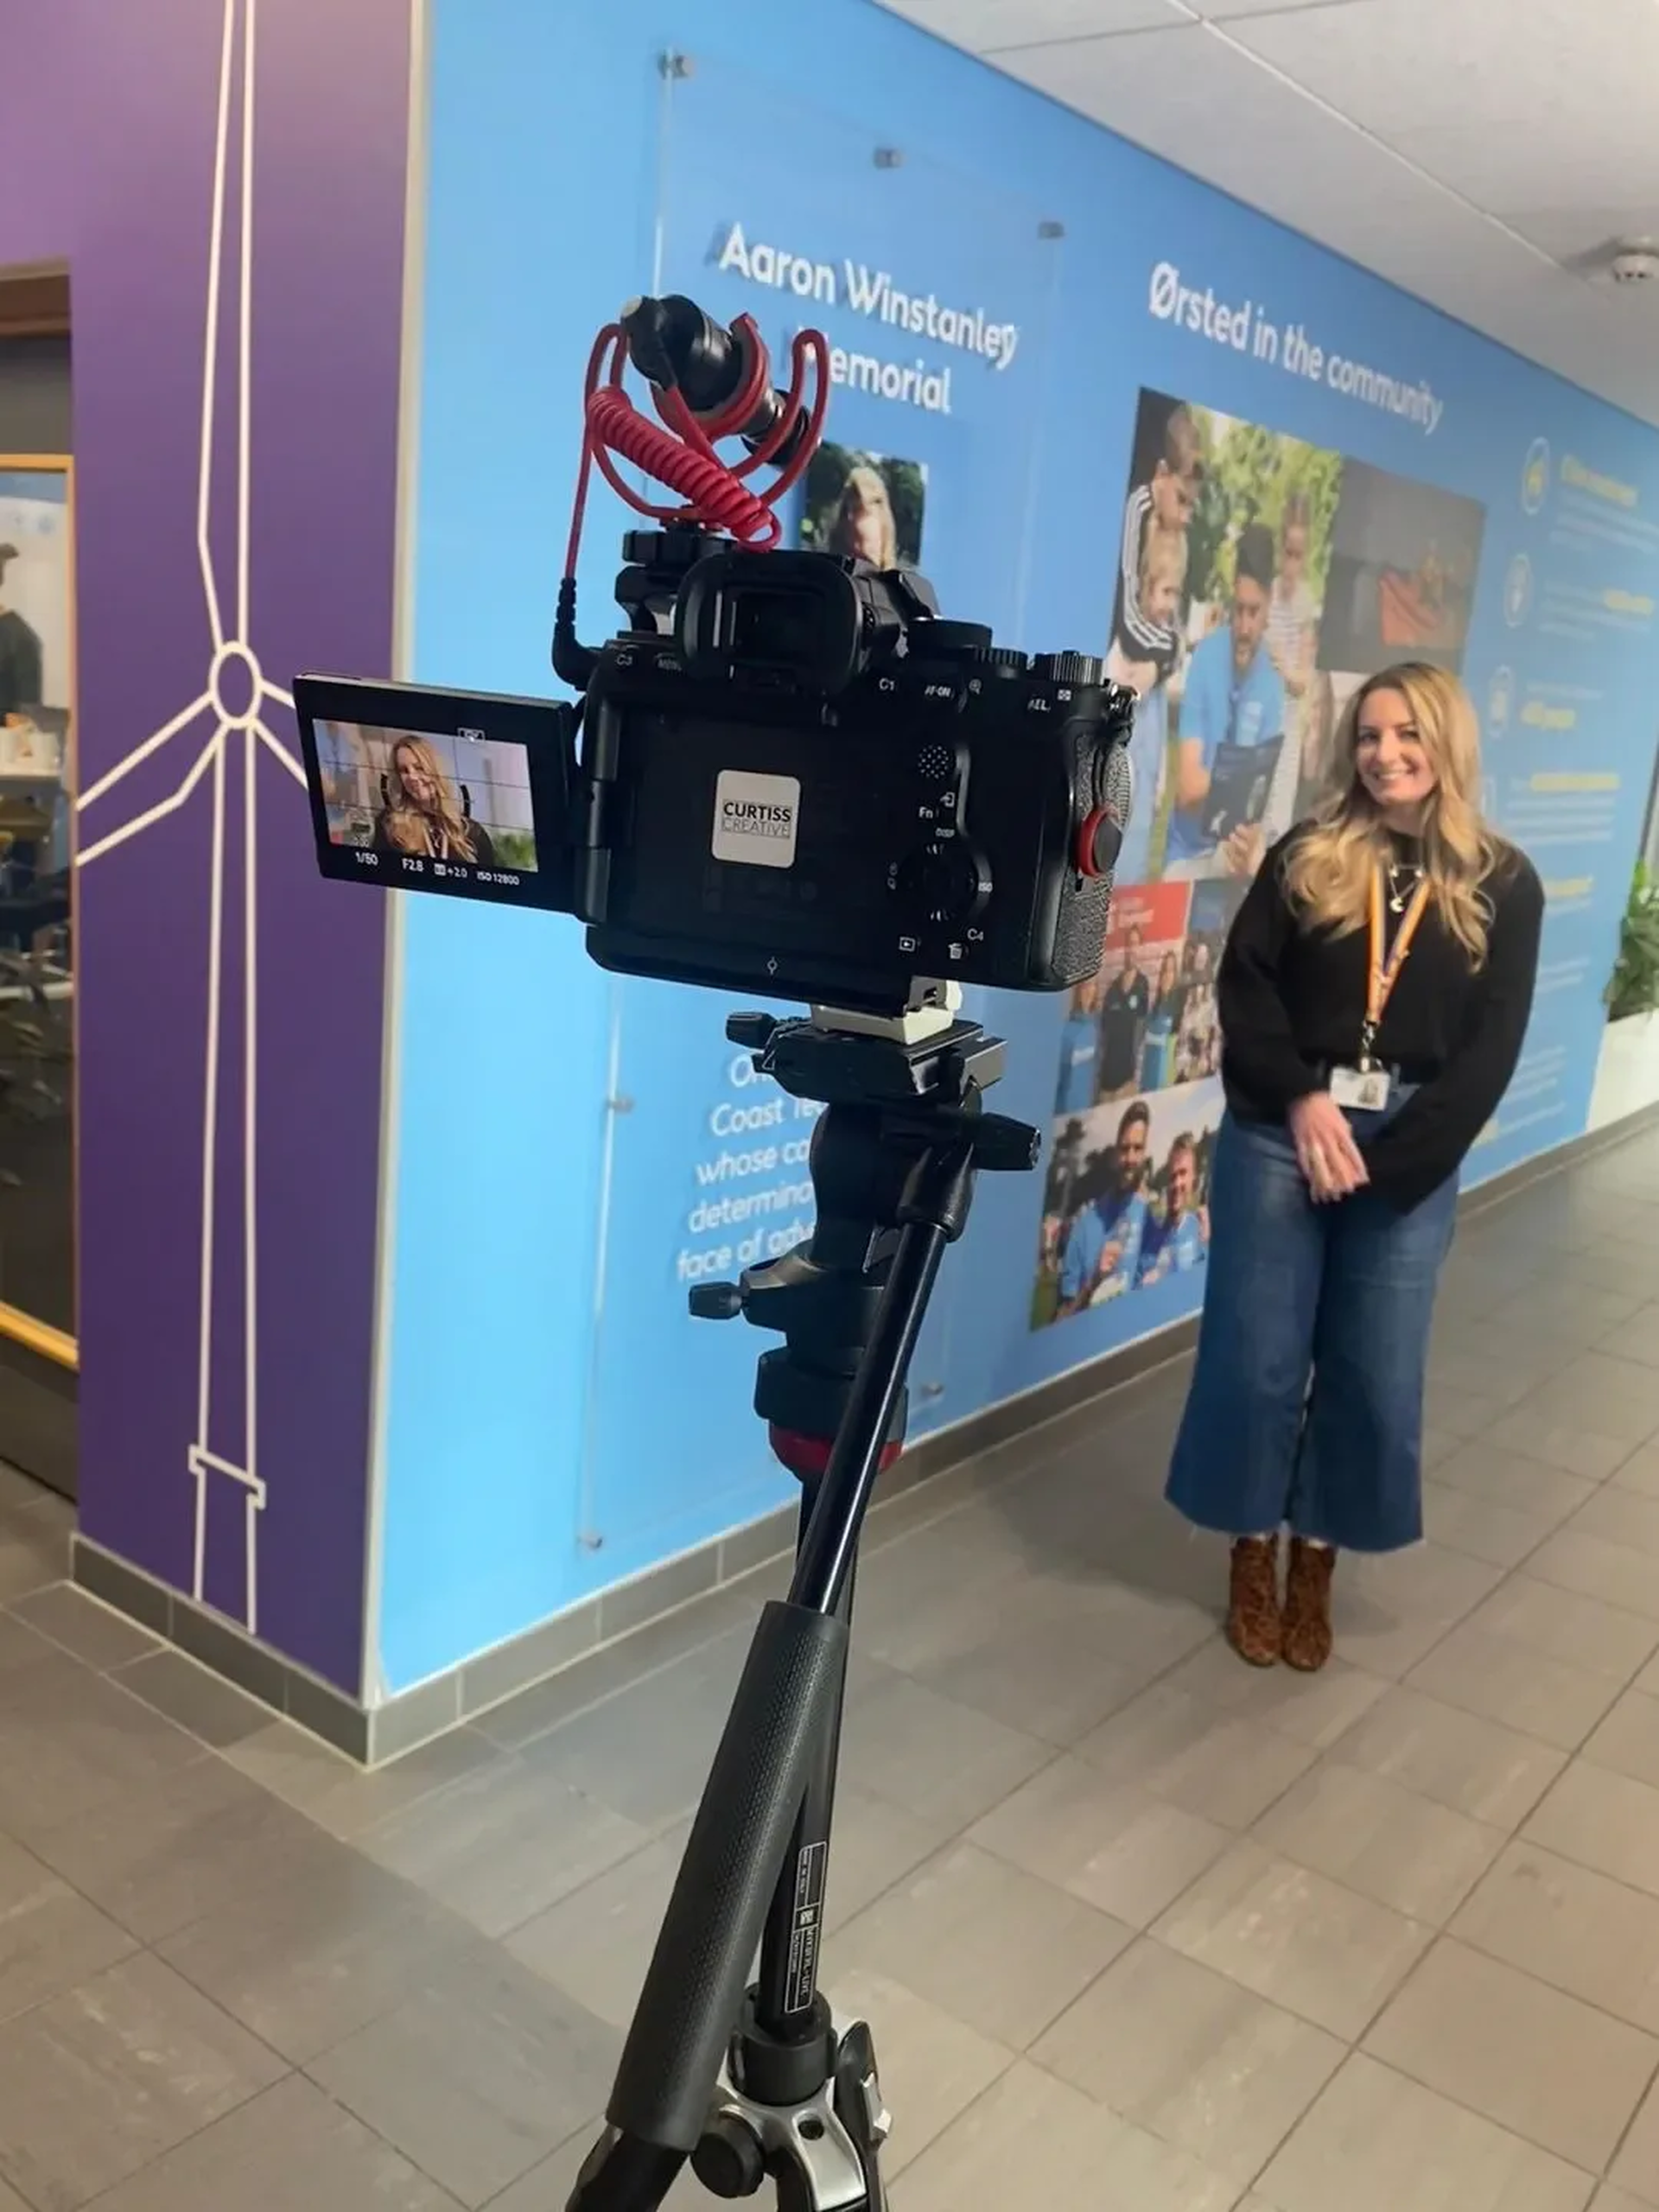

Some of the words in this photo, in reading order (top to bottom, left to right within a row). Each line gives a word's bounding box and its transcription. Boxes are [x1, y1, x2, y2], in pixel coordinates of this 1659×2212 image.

[719, 221, 836, 305] Aaron
[843, 258, 1020, 371] Winstanley
[1148, 261, 1253, 351] Ørsted
[1253, 305, 1280, 365] in
[1283, 323, 1324, 382] the
[1327, 354, 1445, 435] community
[878, 677, 896, 691] C1
[722, 802, 791, 823] CURTISS
[918, 806, 934, 819] Fn
[722, 817, 791, 837] CREATIVE
[355, 851, 379, 867] 1/50
[711, 1098, 784, 1137] Coast
[696, 1151, 778, 1186] whose
[738, 1228, 766, 1263] of
